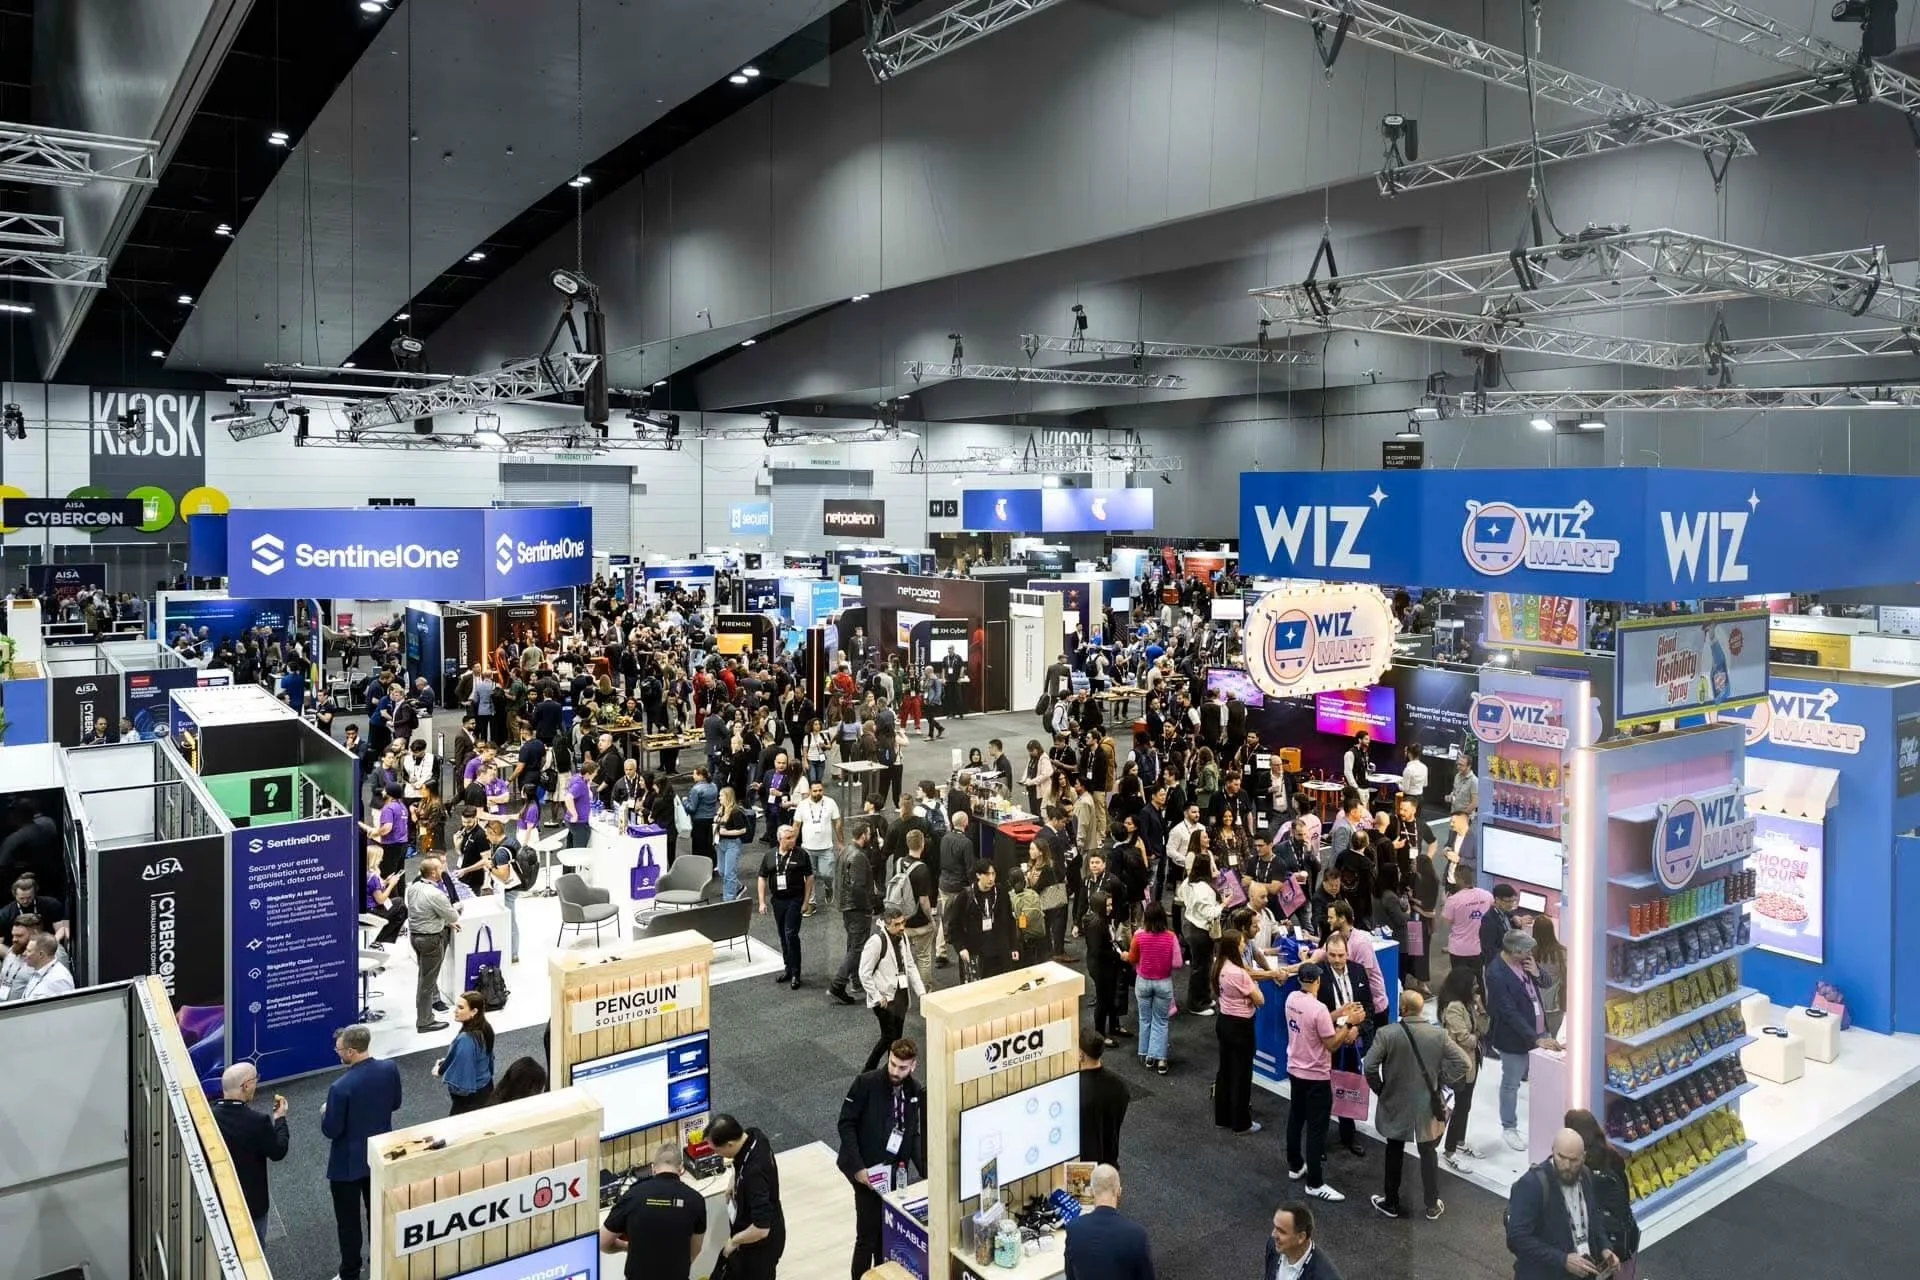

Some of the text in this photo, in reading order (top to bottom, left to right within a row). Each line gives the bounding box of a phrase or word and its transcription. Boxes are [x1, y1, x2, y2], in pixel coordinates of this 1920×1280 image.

[93, 391, 201, 456] KIOSK
[25, 512, 123, 525] CYBERCON
[1525, 512, 1581, 538] WIZ
[1254, 505, 1370, 569] WIZ
[1660, 511, 1749, 584] WIZ
[296, 543, 458, 569] SentinelOne
[517, 539, 584, 564] SentinelOne
[1529, 540, 1615, 568] MART
[55, 571, 80, 579] AISA
[1314, 612, 1352, 636] WIZ
[1318, 637, 1375, 666] MART
[1656, 650, 1697, 686] Visibility
[75, 683, 98, 694] AISA
[1668, 682, 1688, 704] Spray
[1409, 712, 1432, 720] platform
[1510, 704, 1544, 724] WIZ
[1770, 694, 1826, 721] WIZ
[1512, 723, 1566, 746] MART
[1773, 719, 1861, 750] MART
[1702, 795, 1736, 828] WIZ
[267, 834, 330, 848] SentinelOne
[1704, 817, 1758, 864] MART
[142, 858, 184, 880] AISA
[248, 858, 318, 873] Secure your entire
[248, 865, 324, 882] organisation across
[248, 870, 346, 890] endpoint, data and cloud.
[266, 892, 296, 902] Singularity
[159, 897, 175, 988] CYBERCON
[266, 934, 284, 942] Purple
[266, 958, 314, 970] Singularity Cloud
[596, 984, 676, 1016] PENGUIN
[596, 1007, 658, 1026] SOLUTIONS
[1002, 1050, 1044, 1068] SECURITY
[404, 1198, 510, 1248] BLACK
[896, 1222, 928, 1253] N-ABLE
